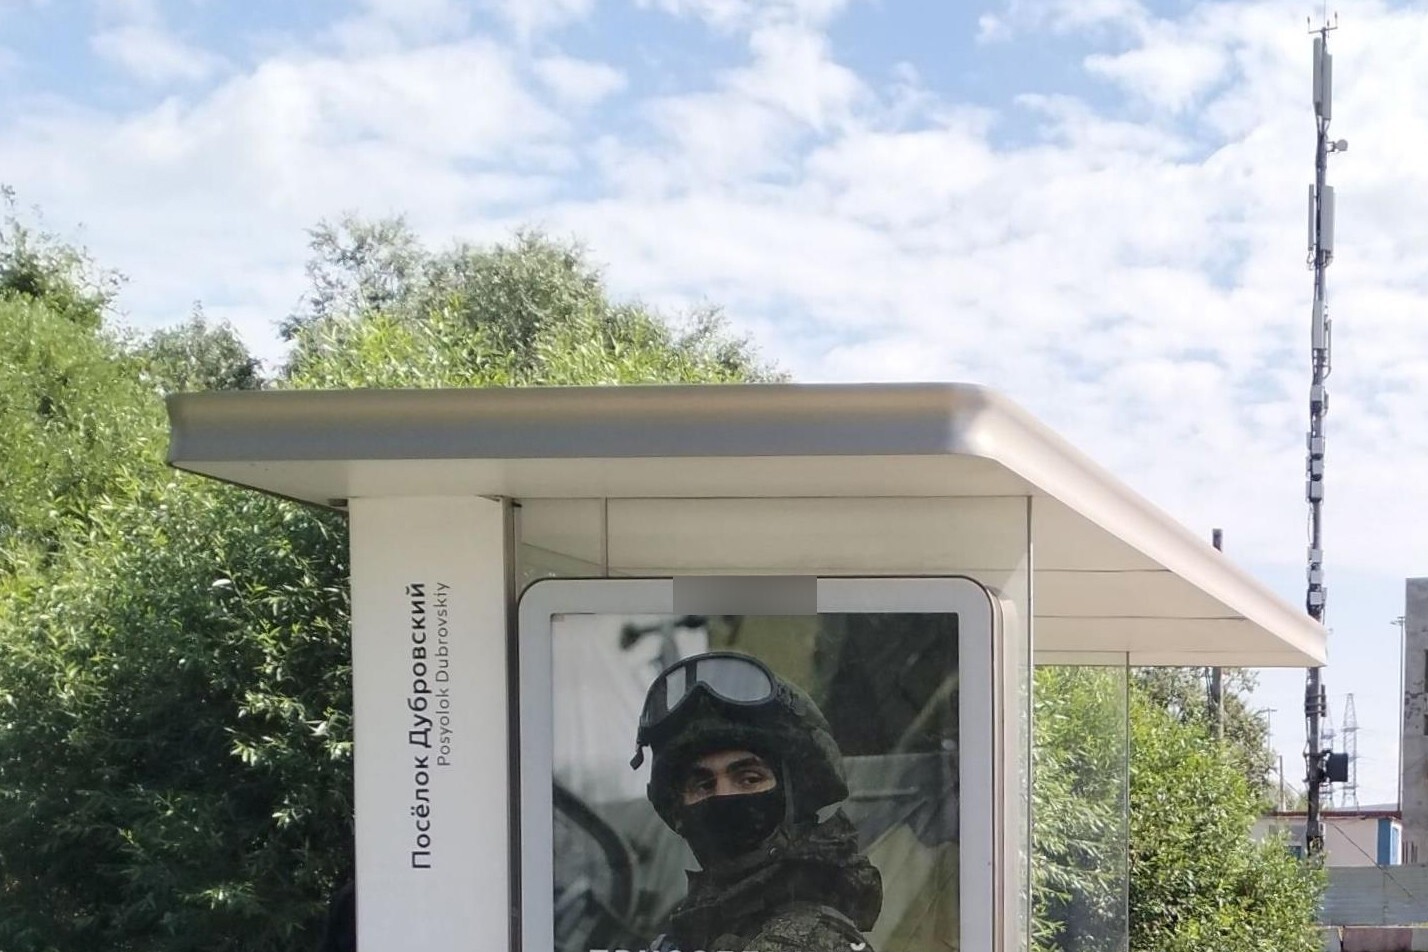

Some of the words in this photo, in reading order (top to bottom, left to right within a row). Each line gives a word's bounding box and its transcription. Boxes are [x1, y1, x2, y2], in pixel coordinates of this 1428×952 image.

[406, 583, 432, 748] Дубровский
[434, 582, 450, 682] Dubrovskiy
[435, 688, 452, 766] Posyolok
[411, 757, 431, 869] Посёлок
